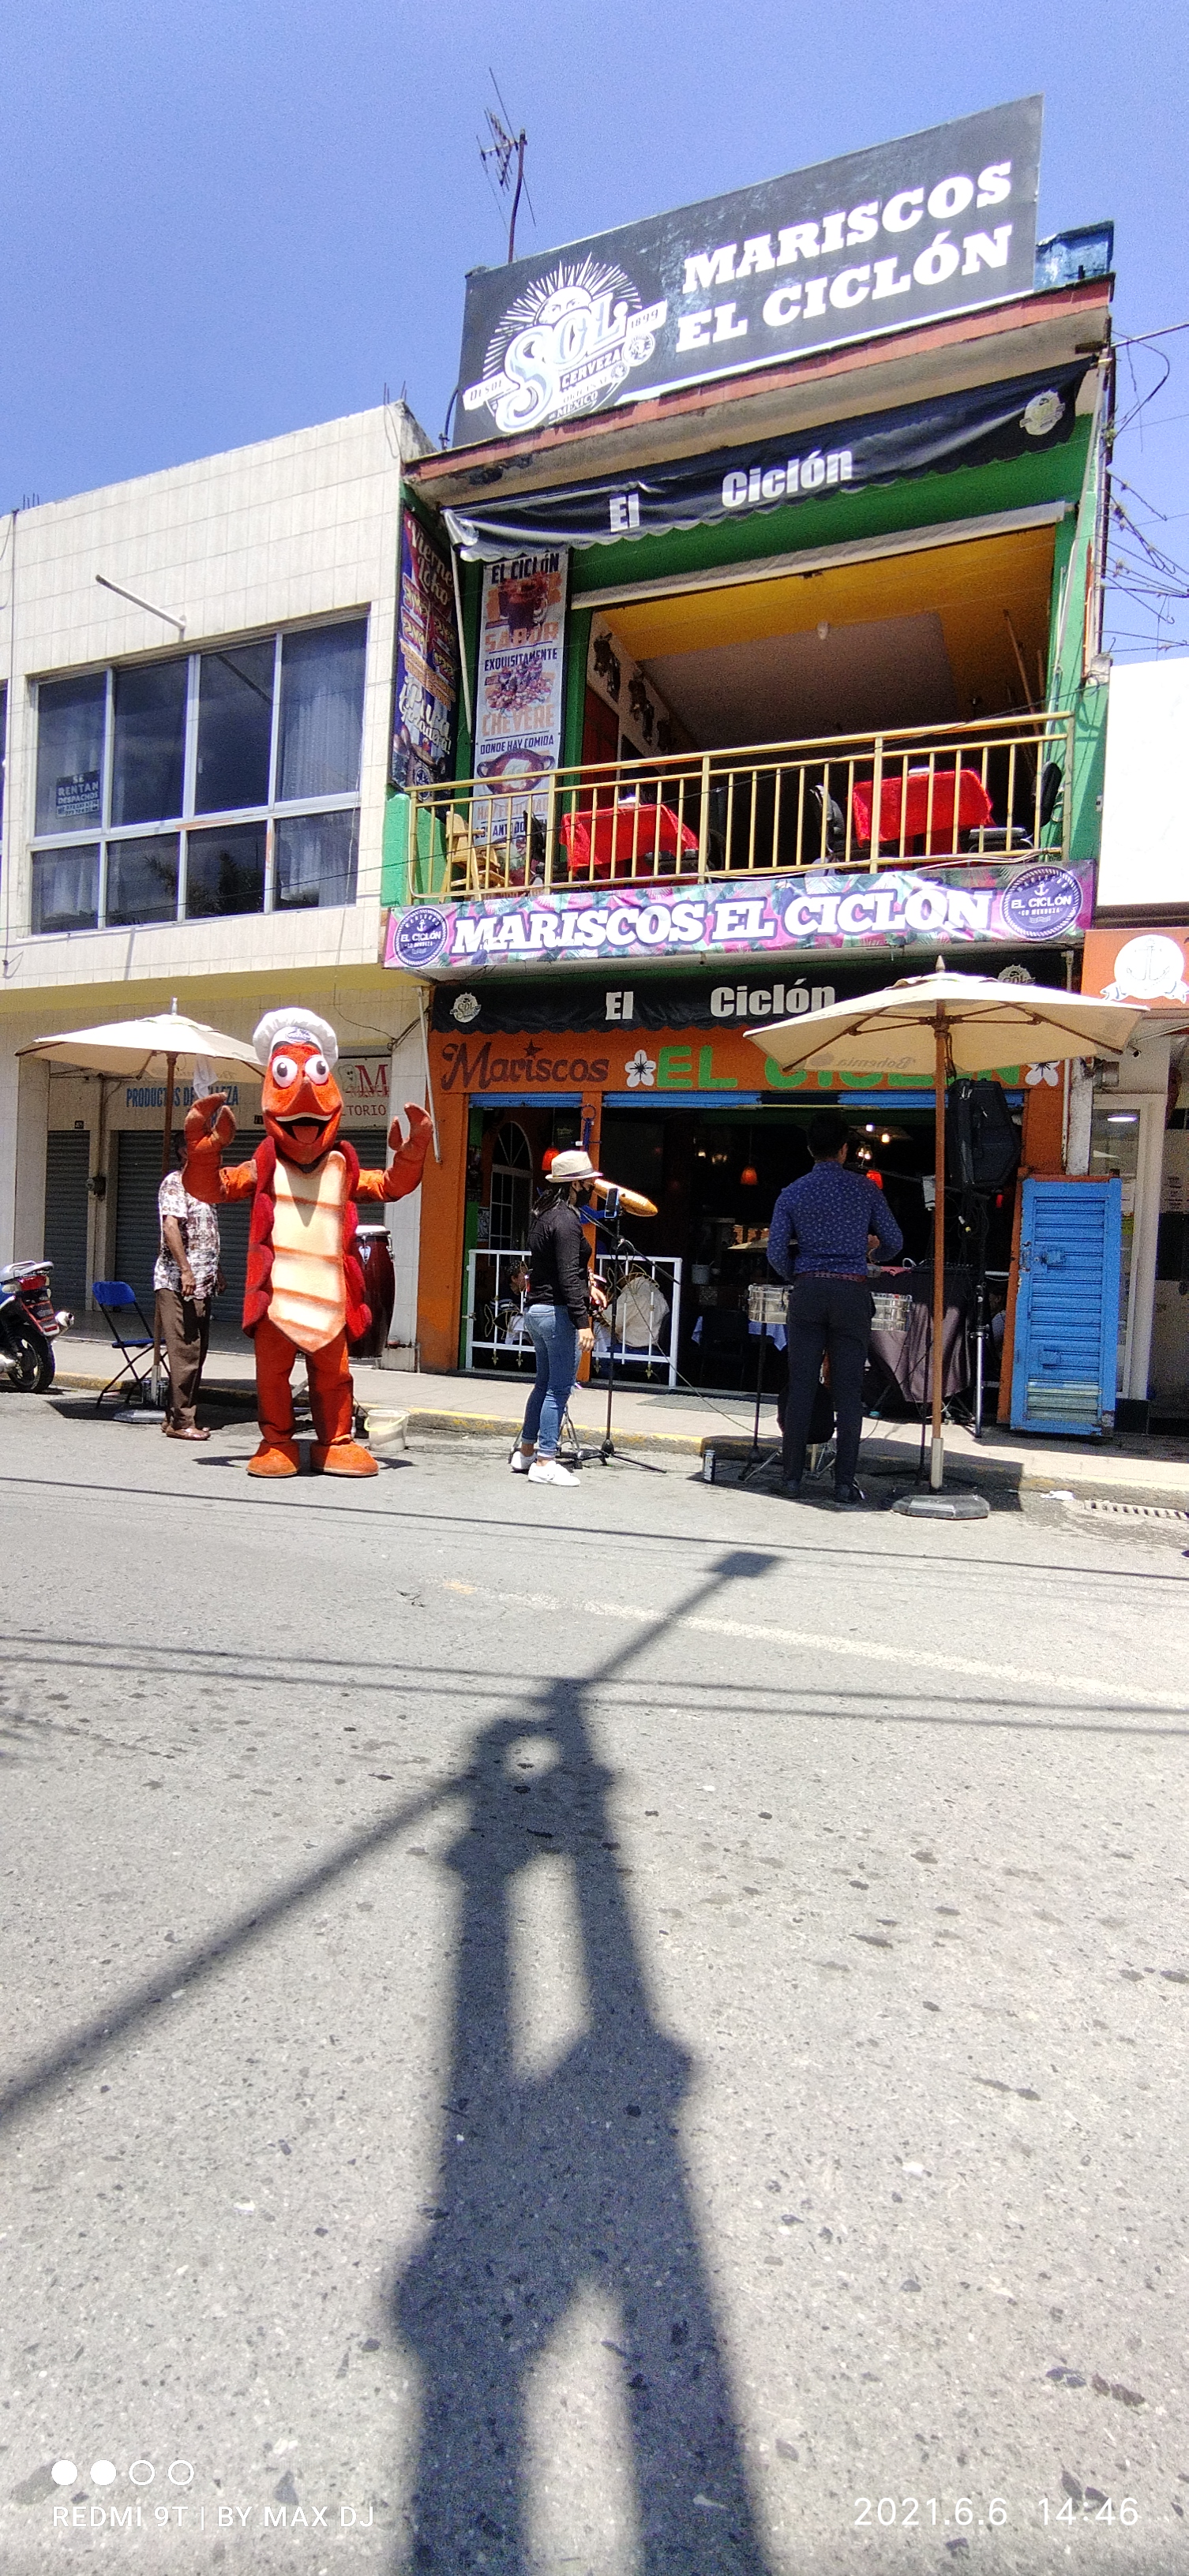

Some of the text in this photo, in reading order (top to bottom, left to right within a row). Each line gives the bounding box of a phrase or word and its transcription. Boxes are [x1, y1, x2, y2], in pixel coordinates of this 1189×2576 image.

[682, 162, 1012, 294] MARISCOS
[676, 224, 1012, 353] EL CICLÓN
[495, 292, 628, 433] SOL
[561, 348, 621, 389] CERVEZA
[610, 449, 852, 532] El Ciclón
[407, 519, 454, 588] Vierne
[492, 552, 560, 585] EL CICLÓN
[485, 622, 559, 653] SABOR
[484, 647, 557, 672] EXQUISITAMENTE
[480, 734, 554, 754] DONDE HAY COMIDA
[58, 781, 99, 796] RENTAN
[73, 774, 84, 784] SE
[58, 792, 98, 804] DESPACHOS
[451, 880, 993, 953] MARISCOS EL CICLÓN
[1011, 893, 1072, 909] EL CICLÓN
[400, 930, 441, 942] EL CICLÓN
[605, 978, 836, 1020] El Ciclón
[441, 1040, 610, 1091] Mariscos
[657, 1046, 737, 1088] EL
[126, 1087, 181, 1108] PRODUCTS
